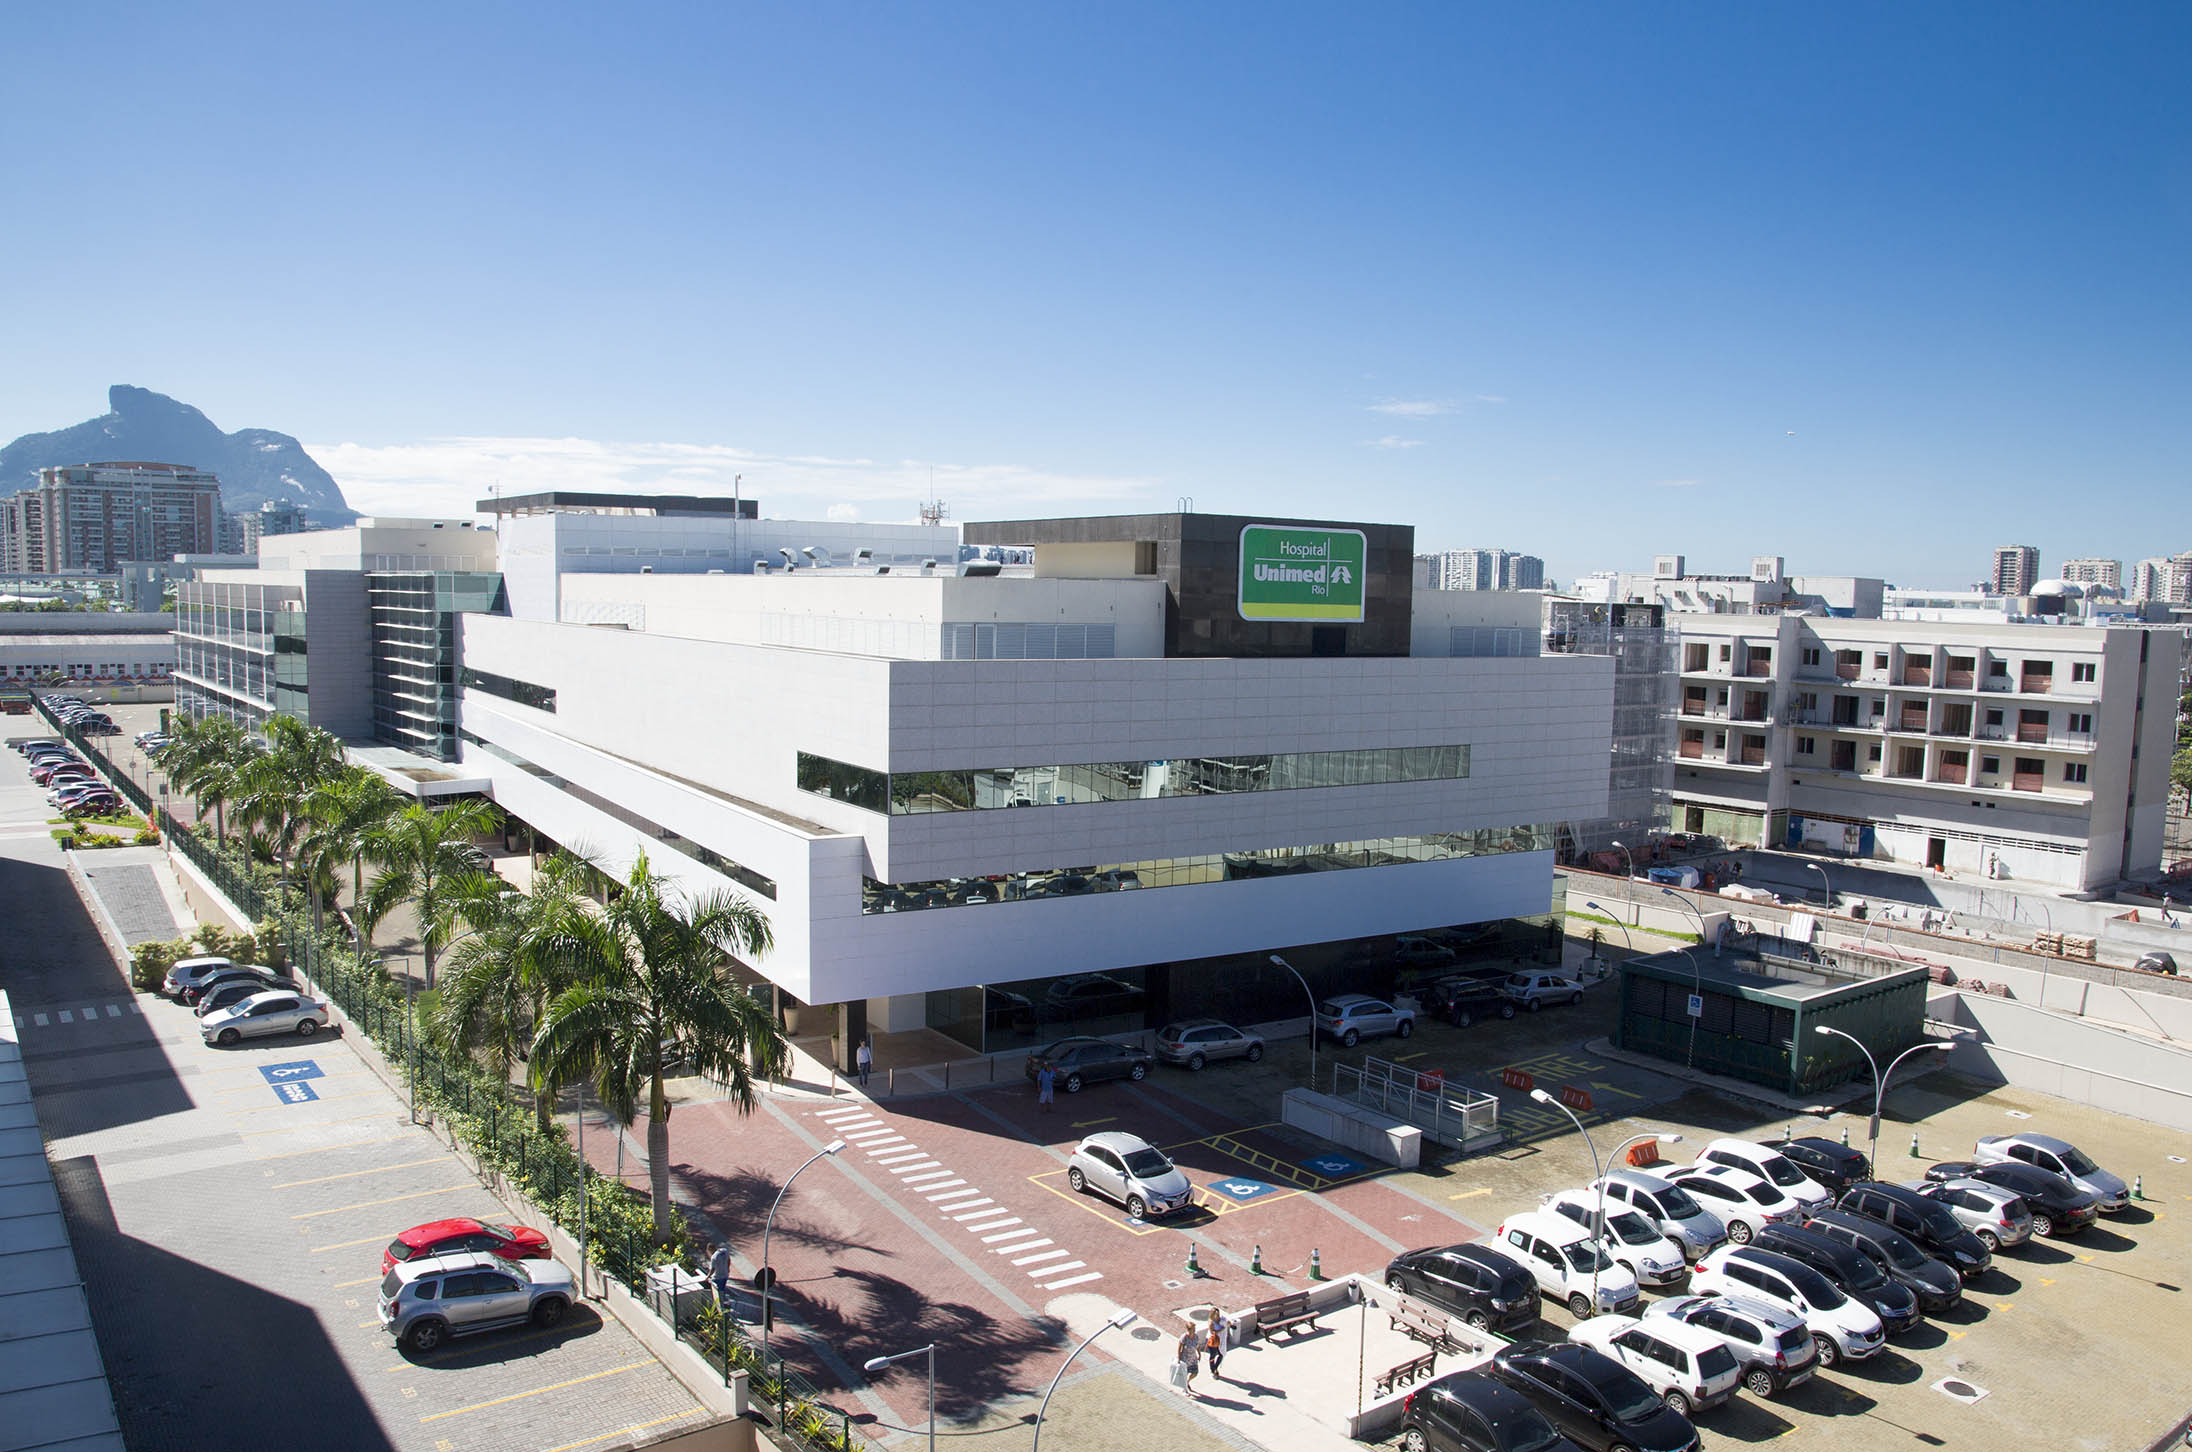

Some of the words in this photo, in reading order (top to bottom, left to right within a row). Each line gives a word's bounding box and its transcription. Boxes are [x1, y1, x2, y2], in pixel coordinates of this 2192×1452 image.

[1280, 540, 1327, 558] Hospital
[1253, 563, 1326, 583] Unimed
[1311, 585, 1326, 595] Rio
[1500, 1055, 1607, 1085] ARE
